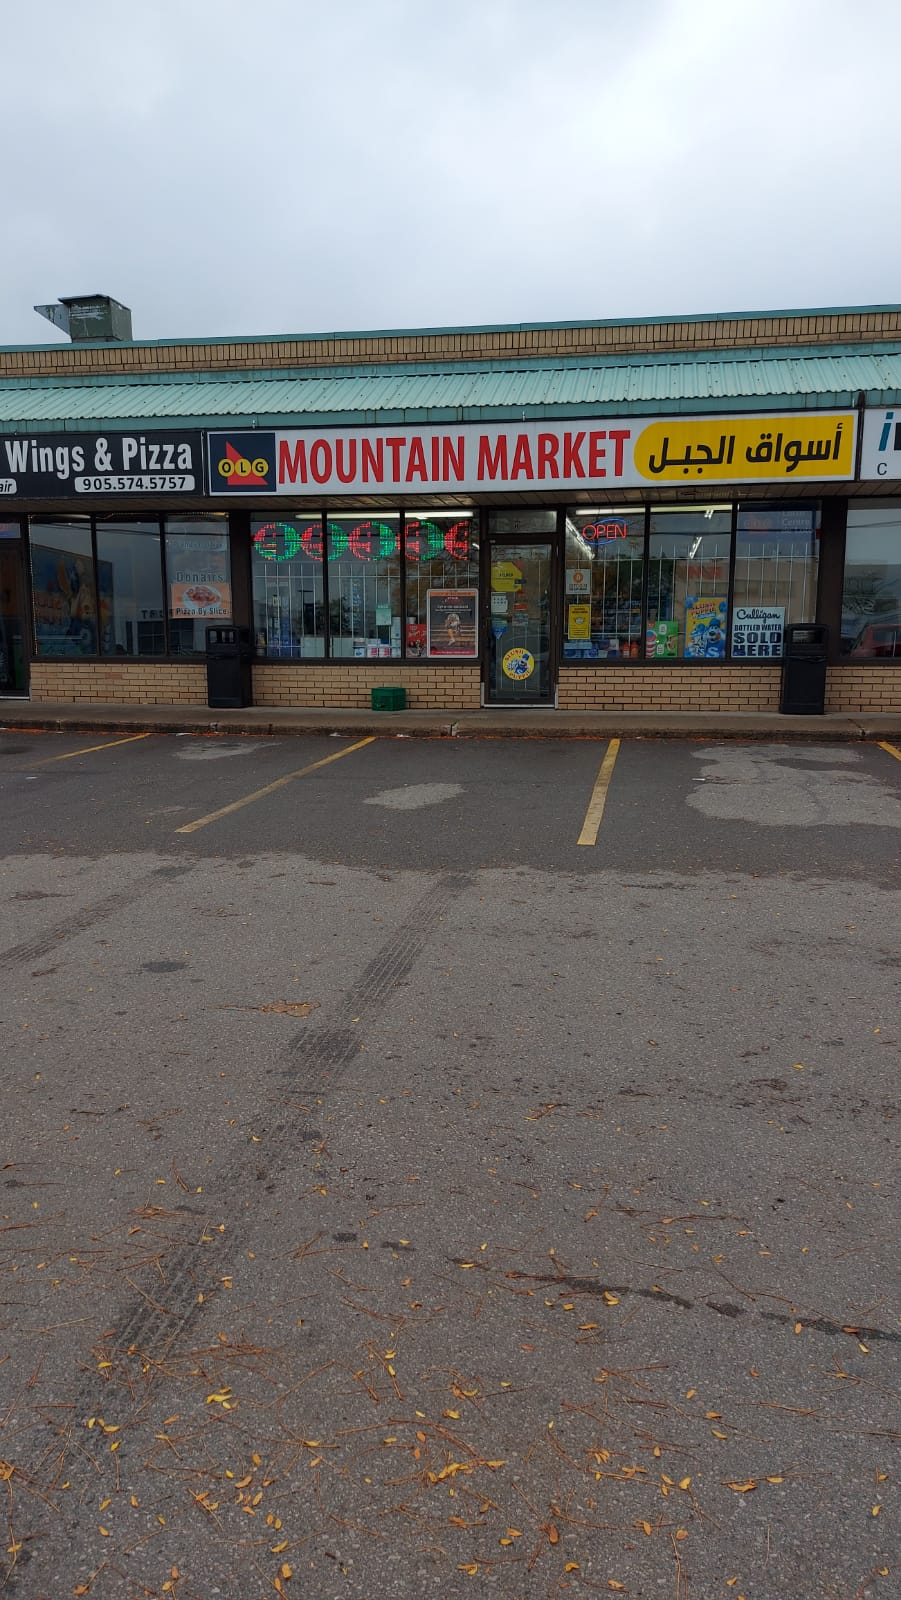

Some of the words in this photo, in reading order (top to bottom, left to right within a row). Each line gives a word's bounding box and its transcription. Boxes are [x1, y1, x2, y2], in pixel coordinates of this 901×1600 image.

[649, 435, 735, 474] الجبل
[746, 422, 843, 473] أسواق
[5, 439, 85, 479] Wings
[94, 437, 113, 471] &
[122, 436, 192, 471] Pizza
[278, 436, 465, 484] MOUNTAIN
[477, 430, 631, 481] MARKET
[220, 460, 266, 475] OLG
[83, 476, 186, 491] 905.574.5757
[582, 524, 627, 540] OPEN
[176, 571, 225, 583] Donairs
[198, 608, 207, 616] By
[736, 608, 781, 624] Culligan
[733, 632, 782, 644] SOLD
[733, 644, 781, 656] HERE
